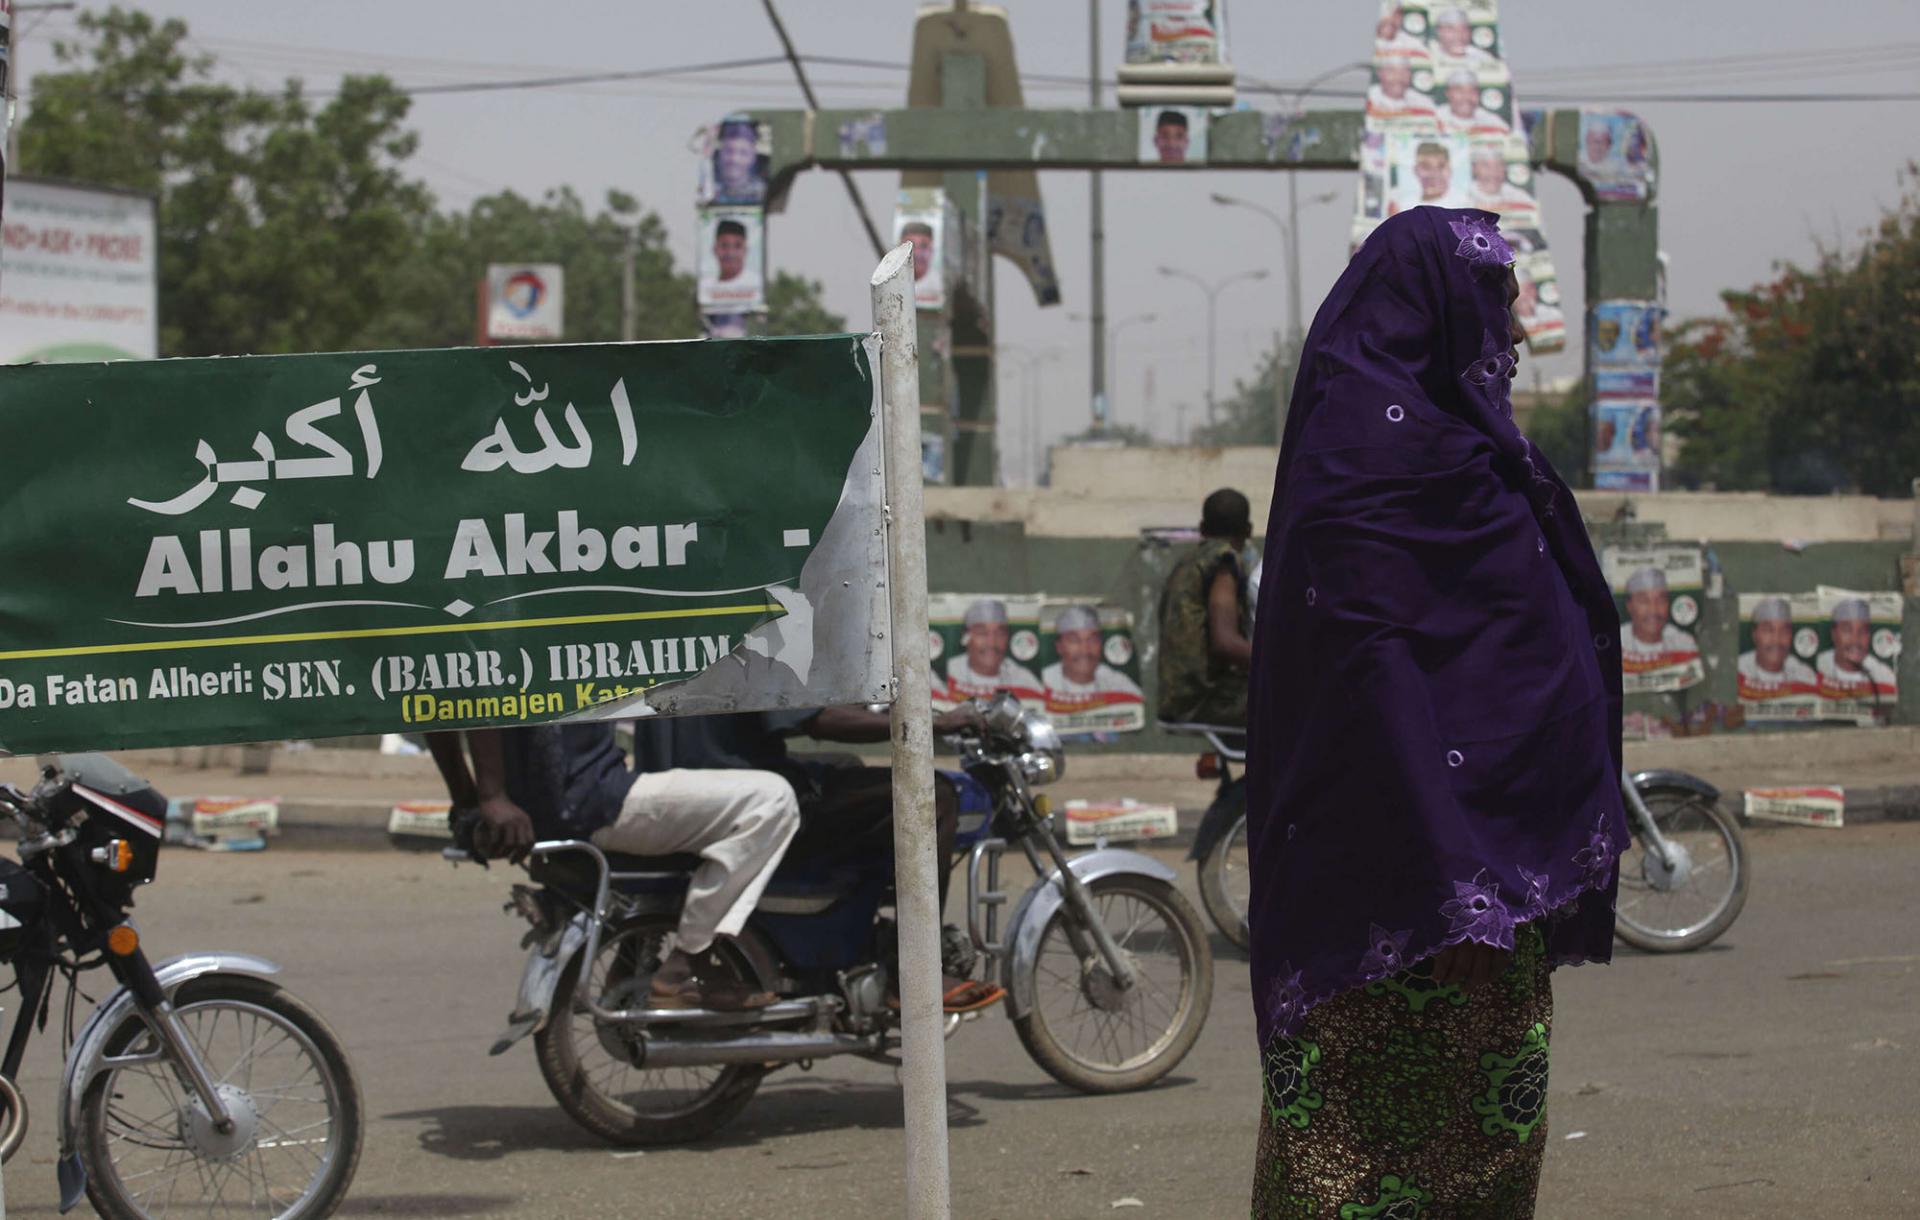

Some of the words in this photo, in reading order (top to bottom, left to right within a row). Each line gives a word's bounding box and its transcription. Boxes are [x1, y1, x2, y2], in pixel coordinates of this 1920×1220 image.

[127, 364, 383, 515] أكبر
[135, 523, 415, 597] Allahu
[443, 510, 698, 579] Akbar
[0, 678, 36, 709] Da
[46, 673, 138, 706] Fatan
[148, 663, 253, 699] Alheri:
[262, 660, 356, 700] SEN.
[371, 646, 534, 700] (BARR.)
[547, 634, 730, 682] IBRAHIM
[401, 687, 564, 723] (Danmajen
